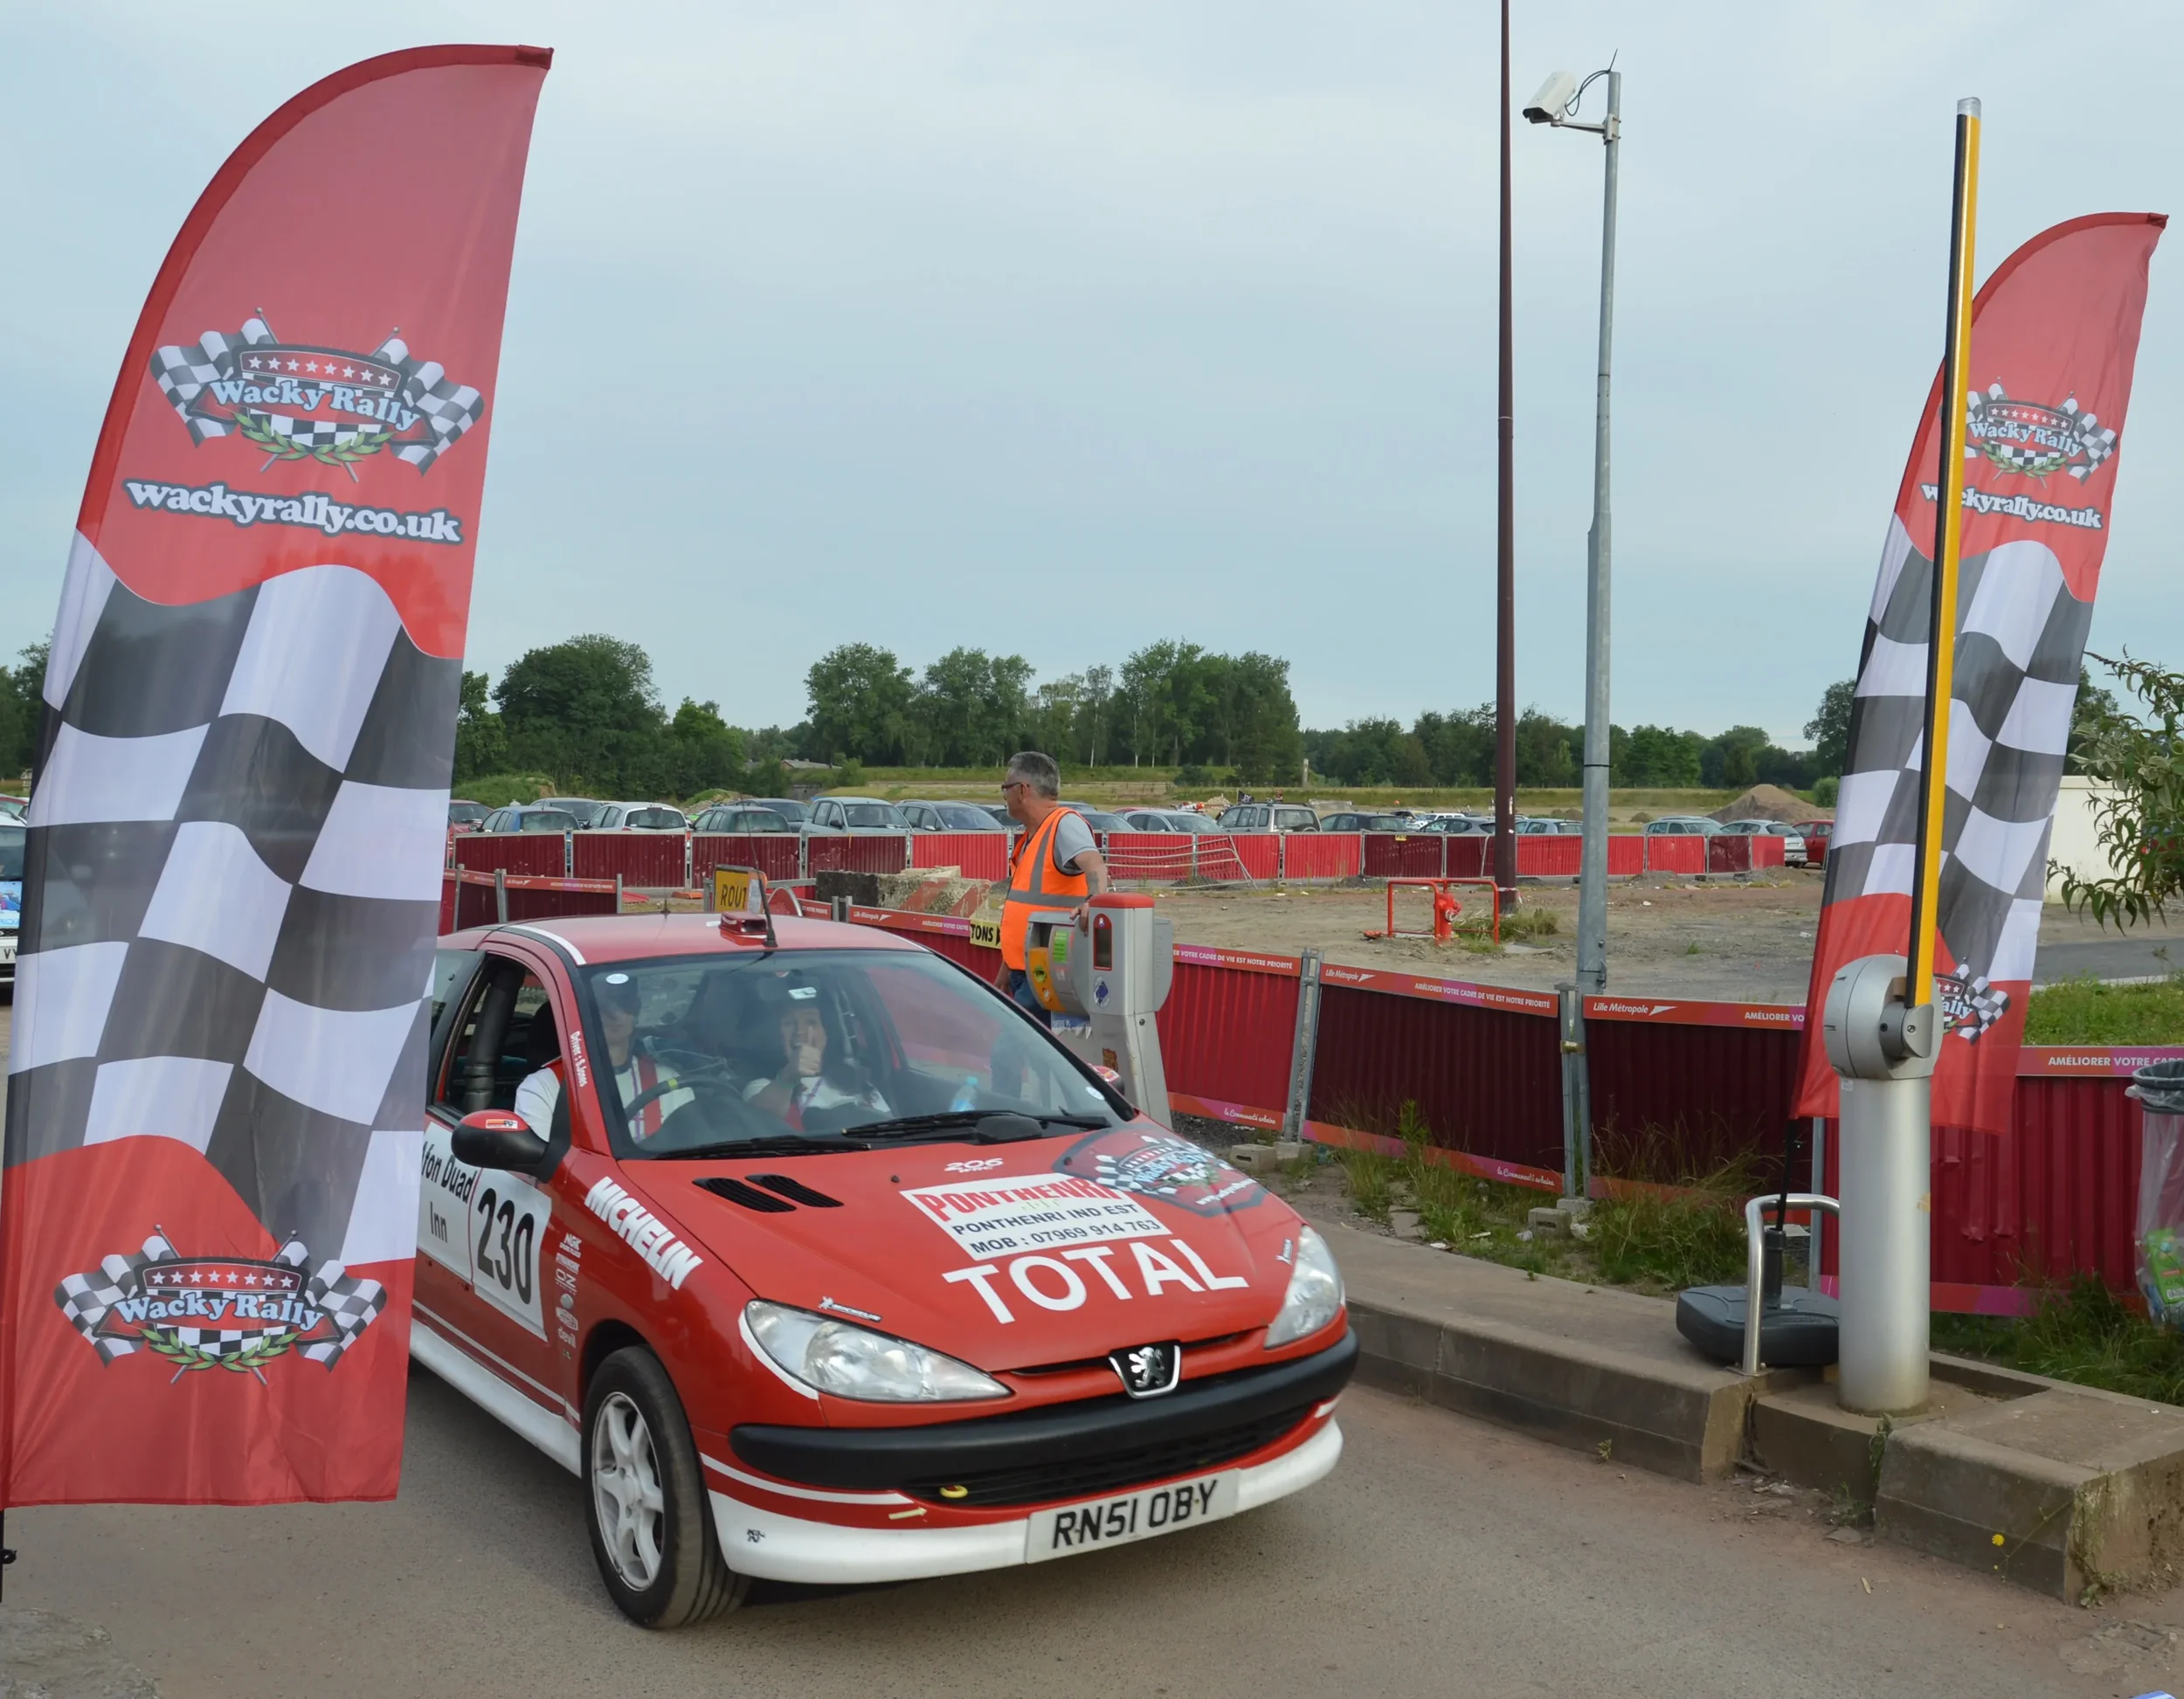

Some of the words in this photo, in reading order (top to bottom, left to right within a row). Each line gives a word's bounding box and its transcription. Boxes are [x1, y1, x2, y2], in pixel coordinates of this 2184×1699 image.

[210, 378, 324, 411] Wacky
[330, 385, 422, 431] Rally
[1969, 421, 2032, 444] Wacky
[2034, 427, 2084, 457] Rally
[126, 480, 462, 542] wackyrally.co.uk
[1921, 483, 2103, 528] wkyrally.co.uk
[1181, 950, 1198, 958] VOTRE
[1199, 951, 1217, 961] CADRE
[1267, 960, 1293, 970] PRIORITÉ
[1414, 982, 1442, 993] AMÉLIORER
[1442, 987, 1459, 996] VOTRE
[1460, 990, 1476, 998] CADRE
[1505, 996, 1524, 1005] NOTRE
[1524, 998, 1551, 1009] PRIORITÉ
[1593, 1002, 1608, 1012] Lille
[1609, 1002, 1648, 1016] Métropole
[1745, 1010, 1791, 1021] AMÉLIORER
[1942, 1000, 1974, 1019] ally
[2048, 1054, 2111, 1067] AMÉLIORER
[2114, 1057, 2150, 1067] VOTRE
[420, 1141, 442, 1184] fon
[944, 1157, 1004, 1171] 206
[912, 1178, 1123, 1222] PONTHENRI
[951, 1211, 1066, 1235] PONTHENRI
[1069, 1206, 1102, 1219] IND
[1102, 1204, 1141, 1215] EST
[430, 1201, 448, 1243] Inn
[584, 1176, 704, 1291] MICHELIN
[970, 1237, 1018, 1254] MOB
[1030, 1226, 1089, 1244] 07969
[1089, 1223, 1126, 1236] 914
[1126, 1219, 1162, 1231] 763
[477, 1188, 535, 1305] 230
[942, 1239, 1250, 1324] TOTAL
[114, 1291, 230, 1325] Wacky
[233, 1292, 325, 1332] Rally
[1052, 1497, 1139, 1549] RN51
[1146, 1478, 1218, 1529] OBY
